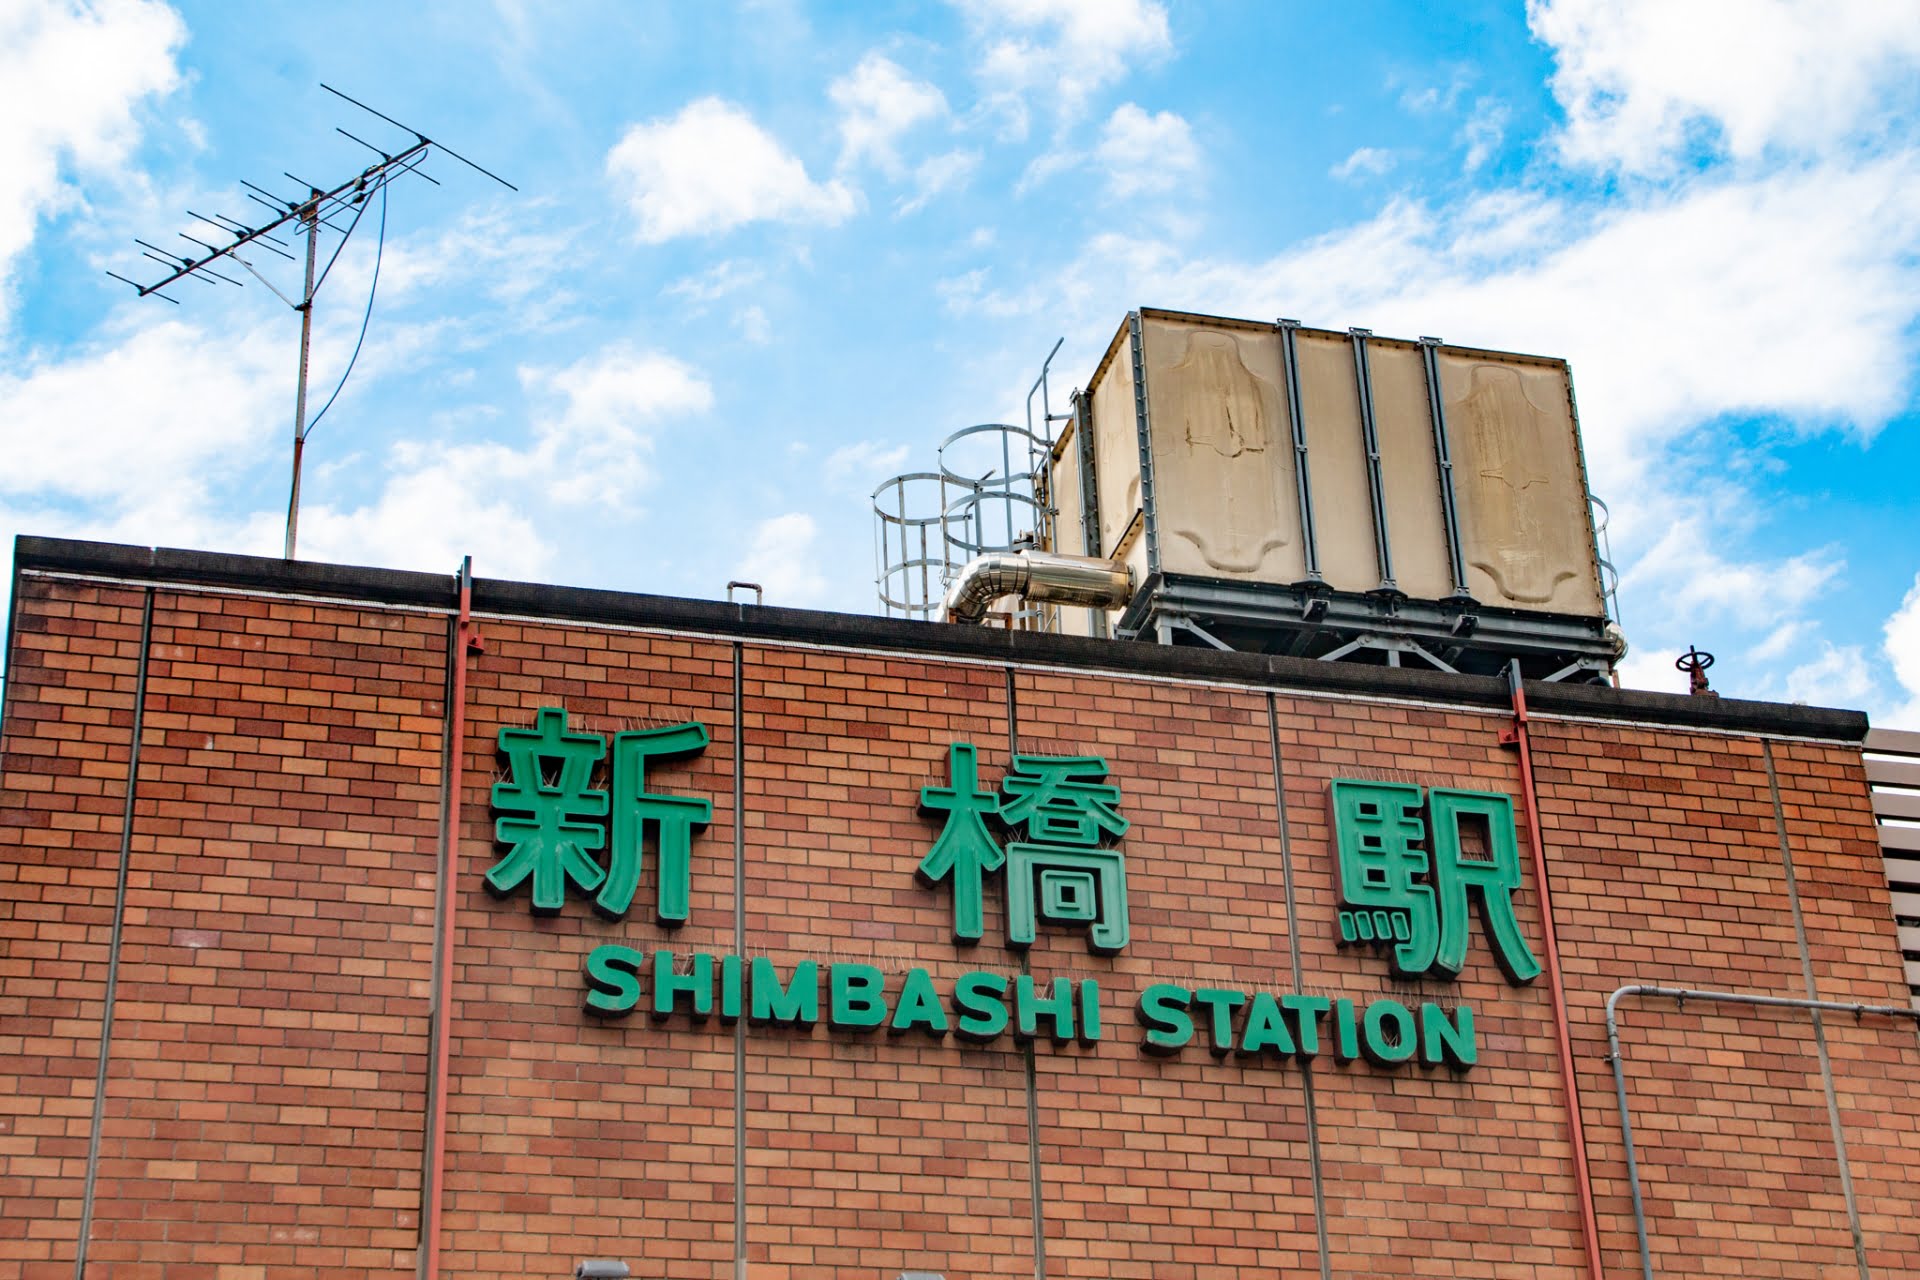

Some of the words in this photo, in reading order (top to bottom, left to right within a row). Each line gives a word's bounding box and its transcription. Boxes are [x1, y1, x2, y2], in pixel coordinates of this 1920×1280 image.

[485, 706, 1542, 980] 新橋駅
[585, 944, 1101, 1043] SHIMBASHI
[1139, 983, 1478, 1066] STATION
